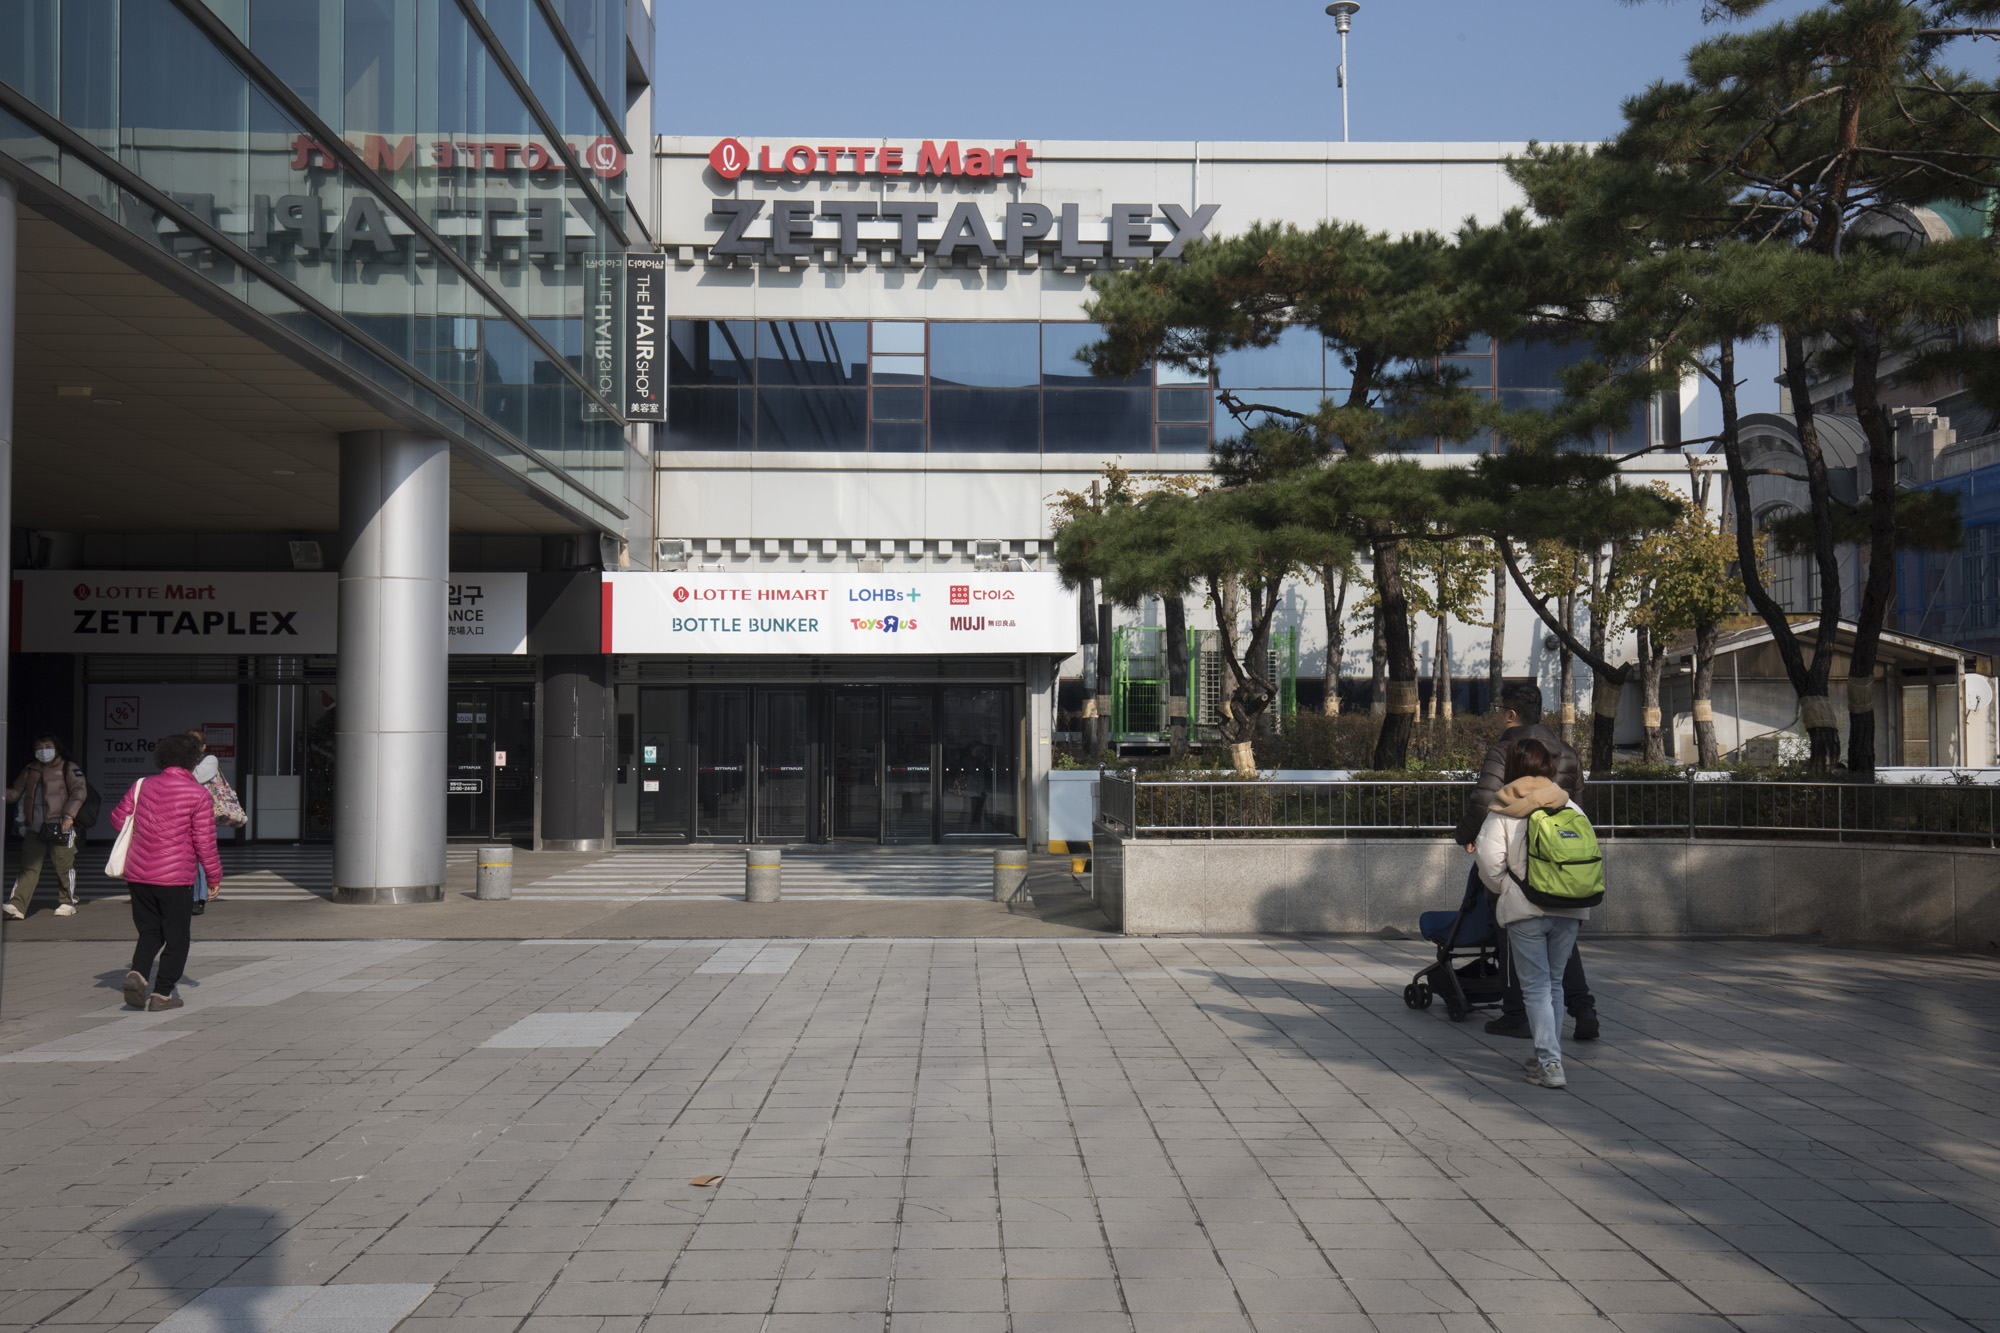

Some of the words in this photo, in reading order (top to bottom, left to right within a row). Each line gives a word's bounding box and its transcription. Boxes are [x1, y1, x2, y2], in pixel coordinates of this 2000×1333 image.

[760, 144, 904, 175] LOTTE
[917, 140, 1034, 178] Mart
[711, 198, 1222, 259] ZETTAPLEX
[630, 403, 659, 413] 美容室
[96, 586, 160, 598] LOTTE
[164, 584, 216, 600] Mart
[694, 589, 752, 600] LOTTE
[758, 589, 829, 600] HIMART
[973, 590, 1015, 600] 다이소
[73, 610, 298, 636] ZETTAPLEX
[672, 618, 741, 632] BOTTLE
[749, 618, 819, 632] BUNKER
[950, 616, 985, 630] MUJI
[104, 739, 133, 751] Tax
[137, 738, 161, 751] Re
